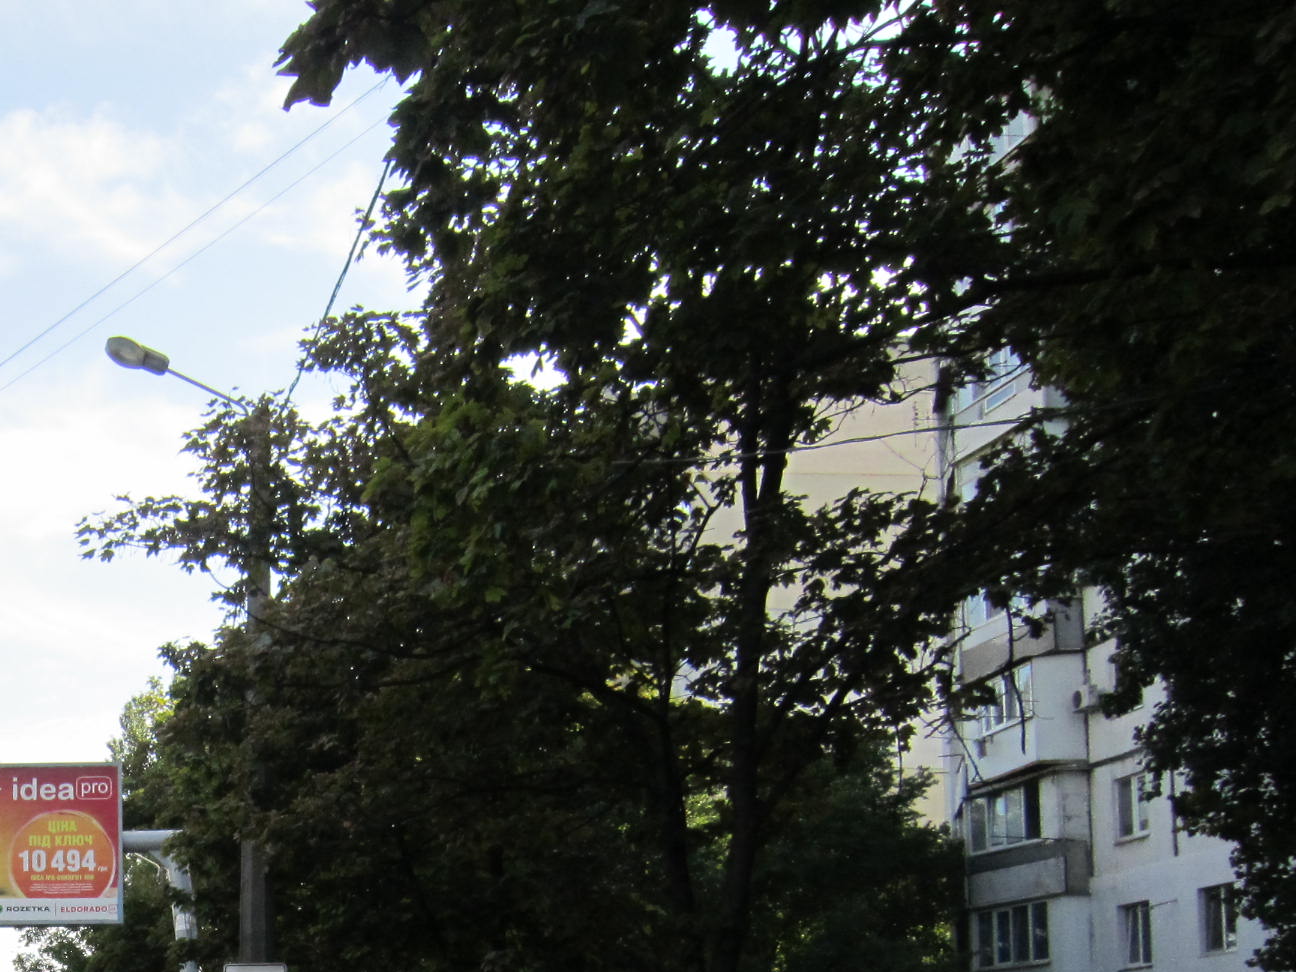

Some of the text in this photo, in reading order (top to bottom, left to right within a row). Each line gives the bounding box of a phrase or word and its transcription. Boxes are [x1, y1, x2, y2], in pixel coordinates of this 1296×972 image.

[12, 777, 108, 801] idea pro
[48, 820, 78, 833] ЦІНА
[28, 834, 93, 848] ПІД КЛЮЧ
[18, 849, 46, 872] 10
[50, 849, 96, 872] 494
